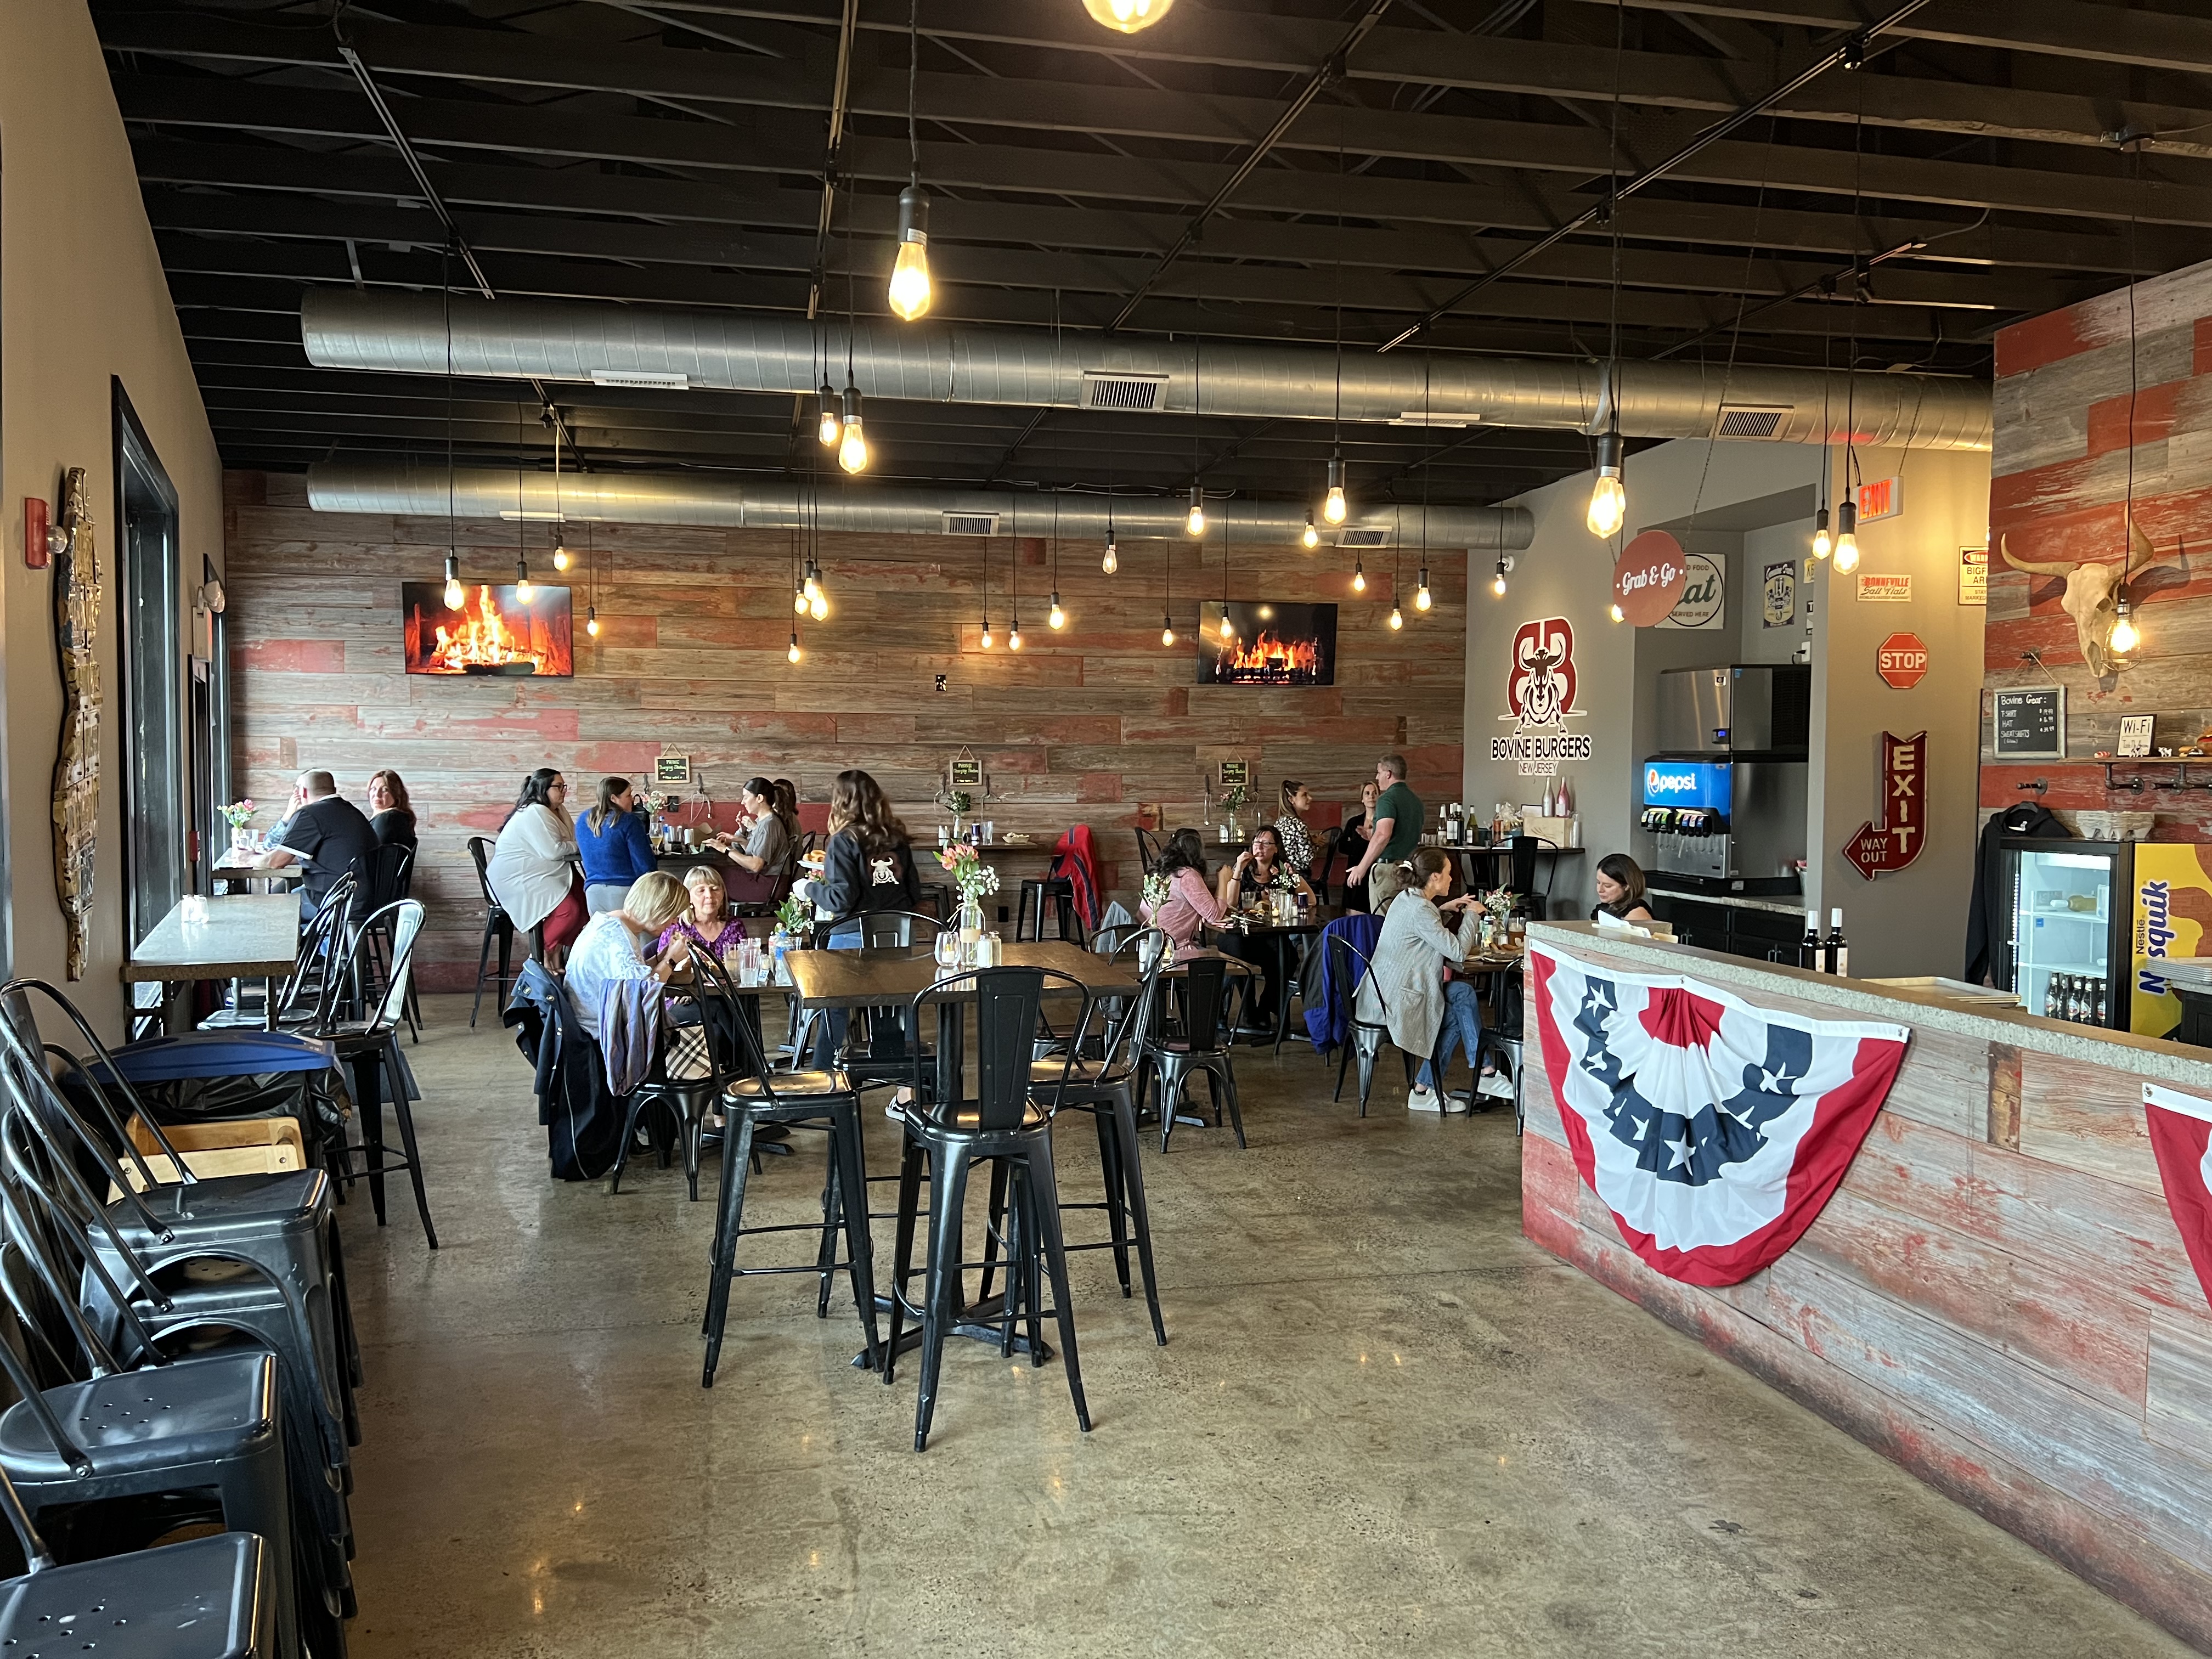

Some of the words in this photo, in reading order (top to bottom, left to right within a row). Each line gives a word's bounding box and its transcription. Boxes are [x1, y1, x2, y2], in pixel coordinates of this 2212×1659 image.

[1859, 479, 1892, 520] EXIT
[1622, 572, 1647, 595] Grab
[1649, 566, 1659, 585] &
[1661, 562, 1676, 587] Go
[1864, 577, 1909, 587] BONNEVILLE
[1678, 574, 1717, 604] at
[1881, 652, 1926, 669] STOP
[2001, 696, 2023, 706] Bovine
[2124, 719, 2151, 733] Wi-Fi
[1492, 738, 1531, 758] BOVINE
[1535, 736, 1591, 758] BURGERS
[1519, 763, 1533, 774] NEW
[1534, 763, 1557, 774] JERSEY
[1660, 772, 1697, 794] pepsi
[1892, 744, 1915, 854] EXIT
[1860, 837, 1888, 850] WAY
[1860, 851, 1888, 863] OUT
[2139, 881, 2175, 994] Nsquik
